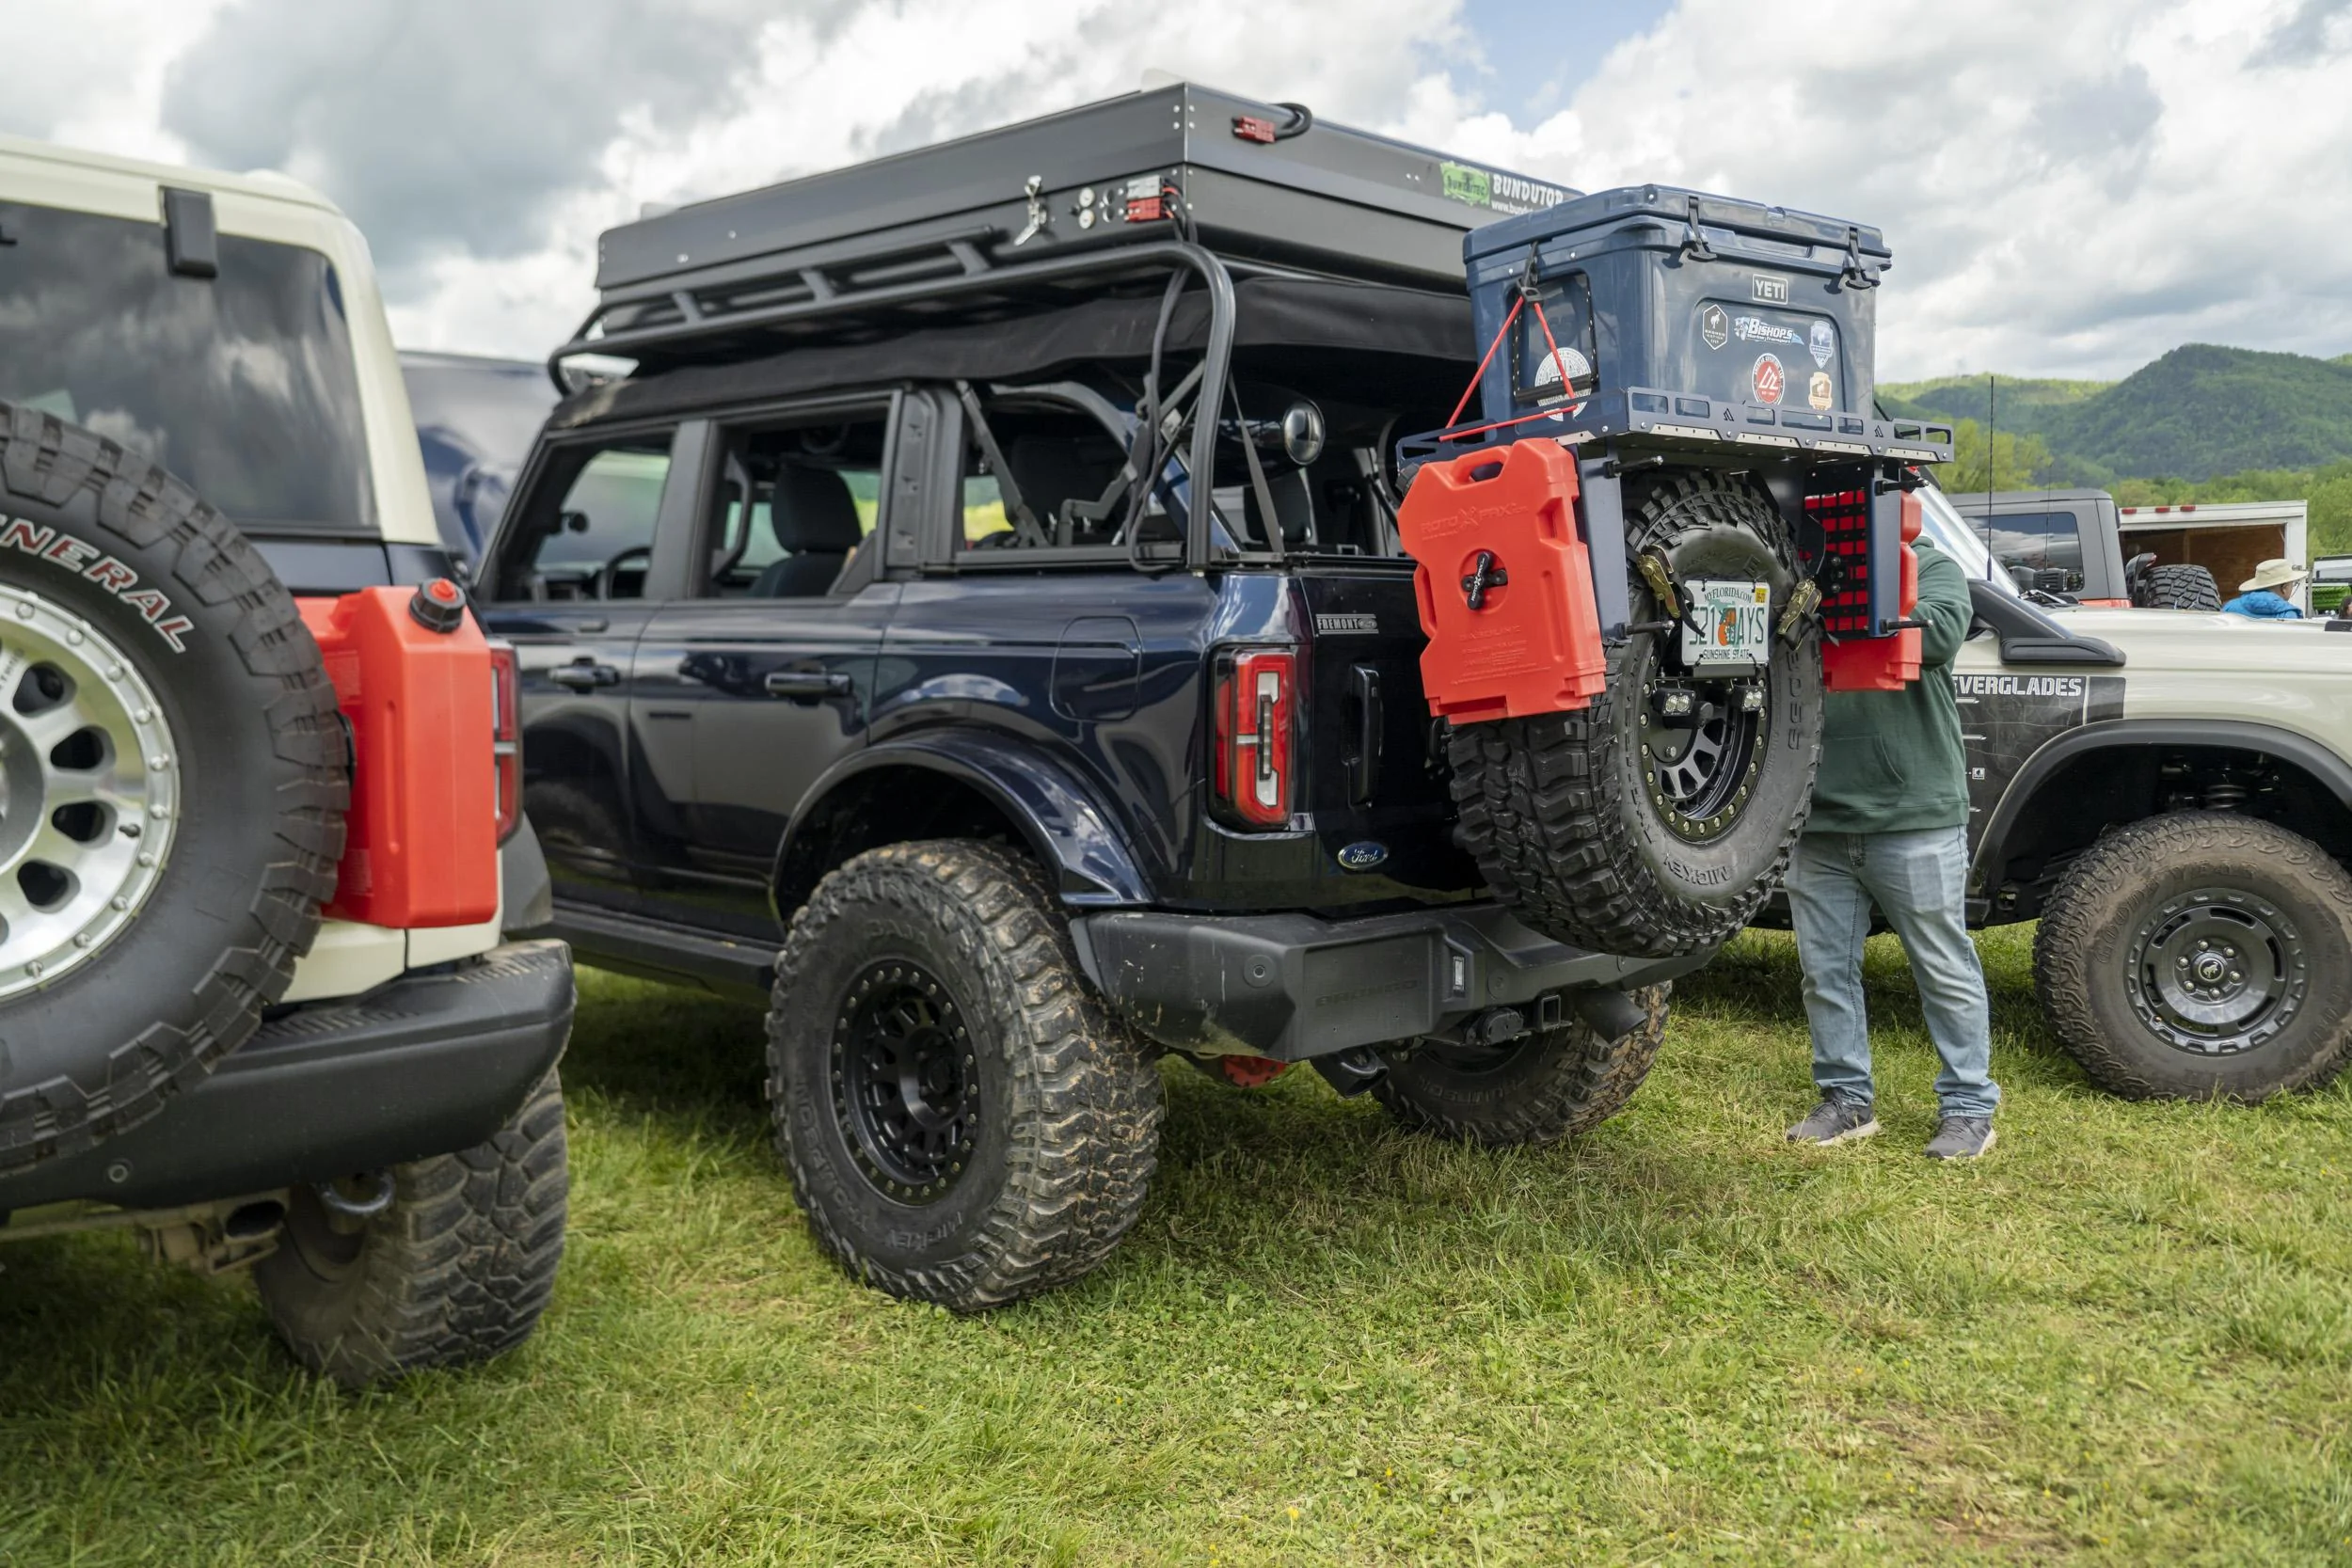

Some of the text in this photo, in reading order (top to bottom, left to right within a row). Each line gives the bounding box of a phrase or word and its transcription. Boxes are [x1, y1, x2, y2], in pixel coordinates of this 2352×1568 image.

[1755, 279, 1785, 299] YETI
[0, 514, 195, 654] NERAL
[1316, 617, 1359, 629] FREMONT
[1703, 648, 1750, 660] SUNSHINE STATE
[1663, 854, 1732, 886] MICKEY
